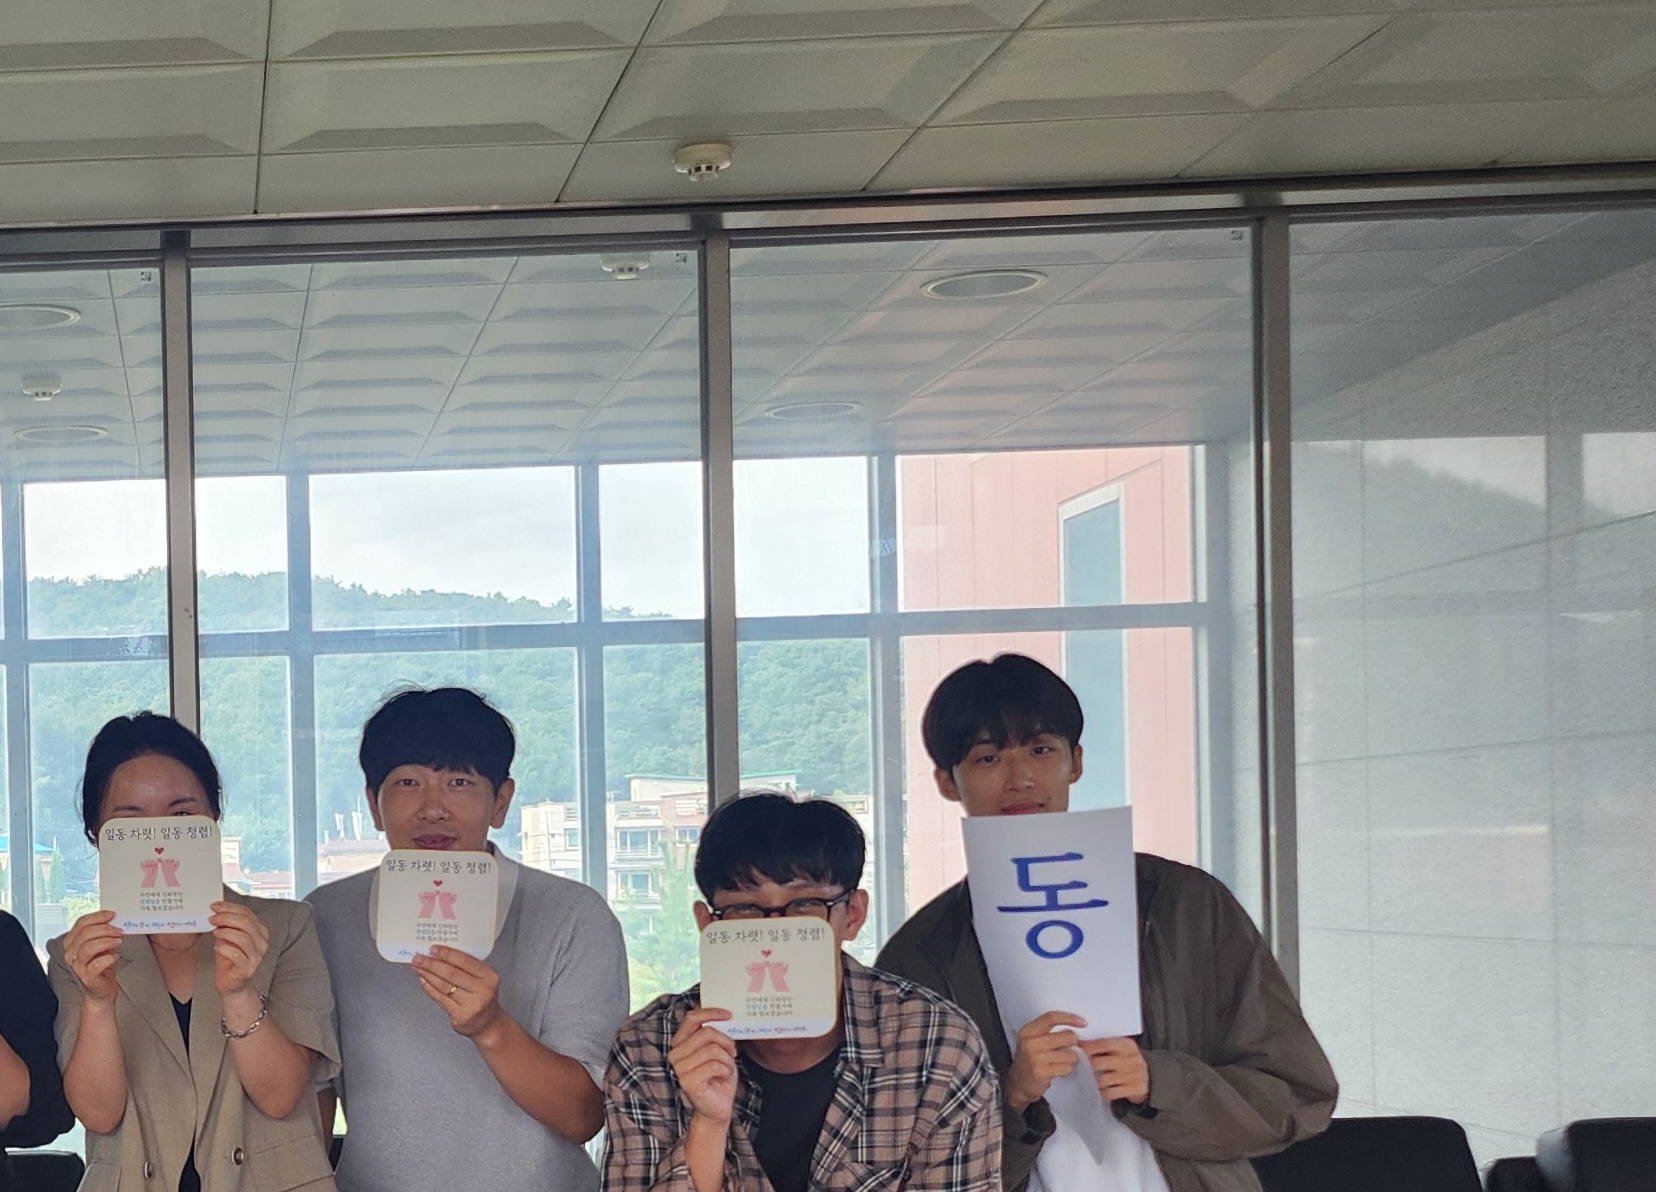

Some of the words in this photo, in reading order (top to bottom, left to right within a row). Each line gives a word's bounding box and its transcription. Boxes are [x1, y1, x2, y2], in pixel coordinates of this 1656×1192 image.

[105, 829, 126, 841] 일동
[130, 828, 156, 840] 차렷!
[161, 827, 183, 840] 일동
[187, 826, 212, 839] 청렴!
[386, 859, 407, 871] 일동
[410, 860, 436, 873] 차렷!
[440, 861, 462, 874] 일동
[466, 862, 490, 874] 청렴!
[997, 851, 1109, 960] 동
[706, 931, 730, 944] 일동
[734, 930, 763, 943] 차렷!
[768, 929, 791, 942] 일동
[796, 928, 824, 941] 청렴!
